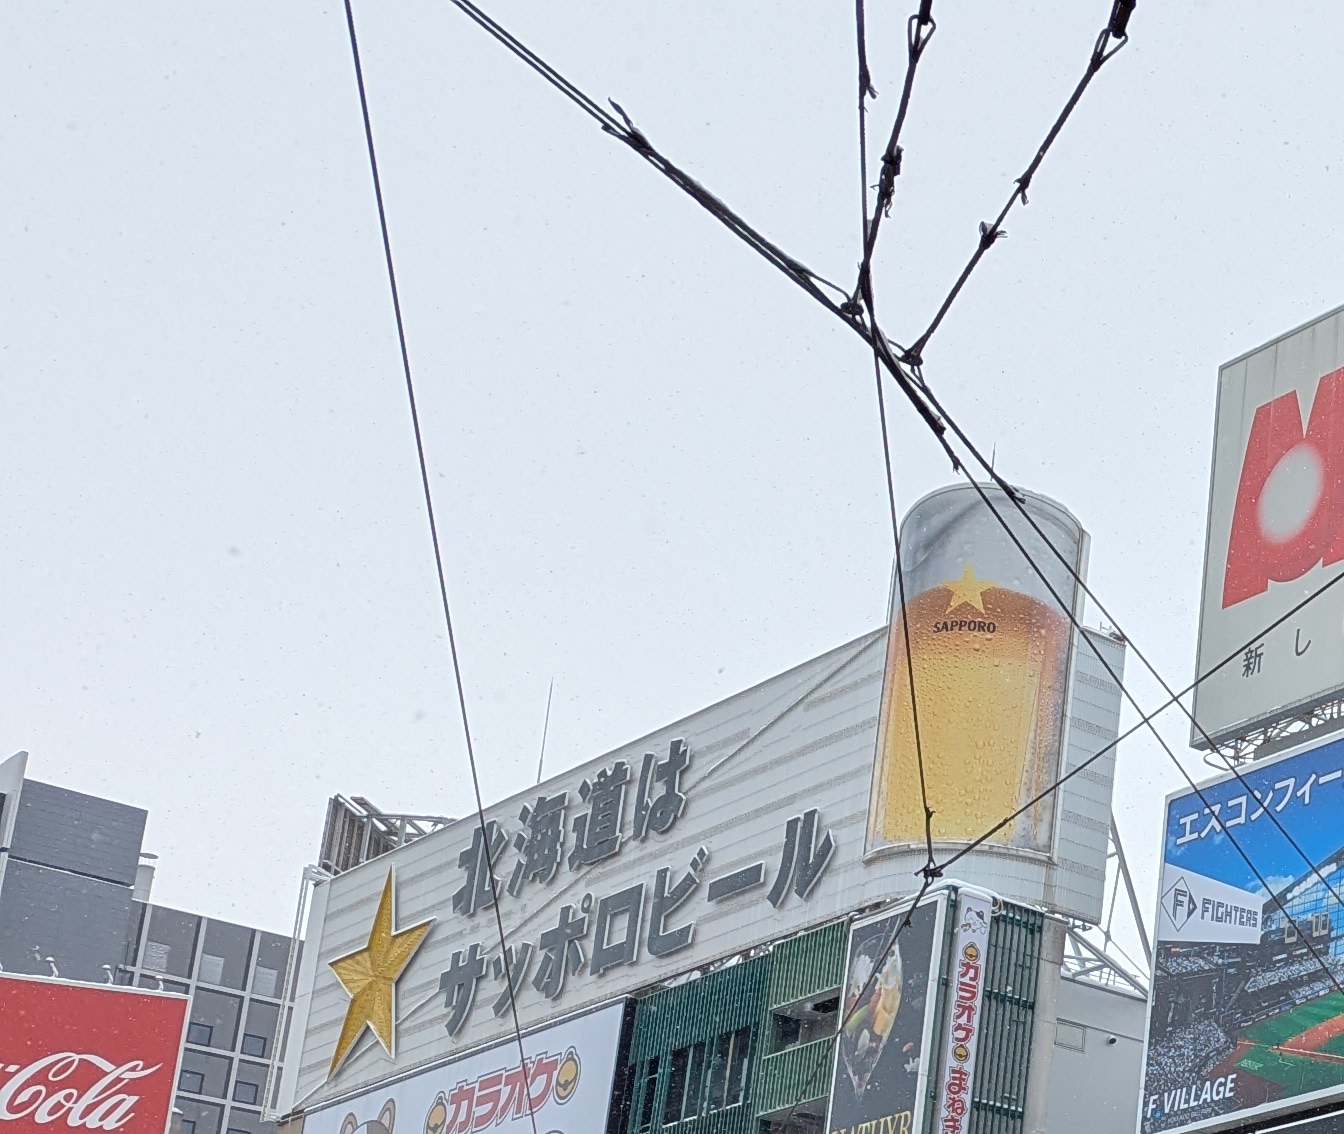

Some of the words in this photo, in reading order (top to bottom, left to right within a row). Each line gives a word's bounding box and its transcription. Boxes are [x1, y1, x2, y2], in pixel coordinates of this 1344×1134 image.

[931, 616, 998, 636] SAPPORO
[450, 736, 692, 919] 北海道は
[438, 806, 838, 1038] サッポロビール
[1201, 898, 1258, 931] FIGHTERS
[952, 961, 982, 1046] カラオケ
[445, 1052, 559, 1133] カラオケ
[1147, 1094, 1159, 1119] F
[1163, 1073, 1237, 1114] VILLAGE
